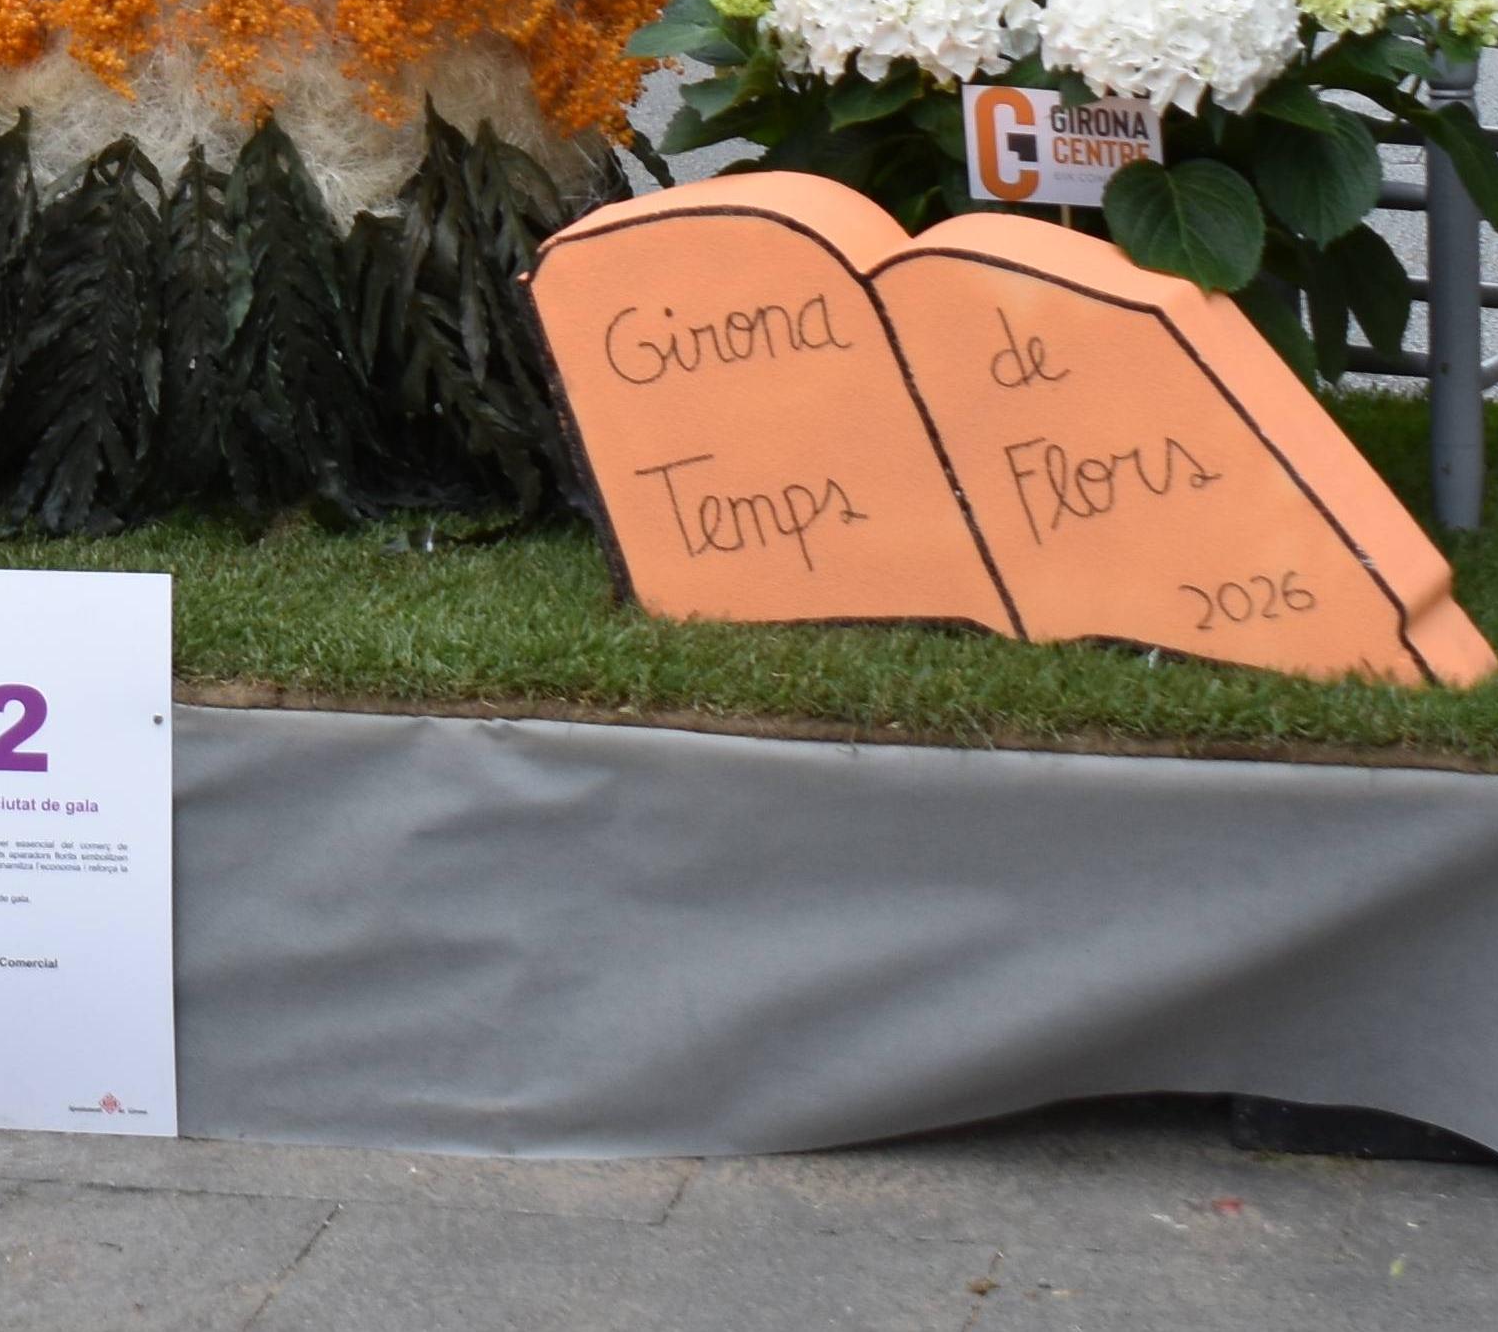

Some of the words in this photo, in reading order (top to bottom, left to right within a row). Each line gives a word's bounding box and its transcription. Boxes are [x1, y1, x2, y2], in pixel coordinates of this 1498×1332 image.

[1050, 104, 1150, 140] GIRONA
[1054, 137, 1150, 167] CENTRE
[606, 293, 853, 387] Girona
[990, 308, 1071, 389] de
[634, 454, 870, 572] Temps
[1004, 437, 1221, 545] Flors
[1178, 571, 1317, 631] 2026
[41, 797, 60, 812] de
[65, 799, 100, 816] gala
[0, 957, 59, 969] Comercial
